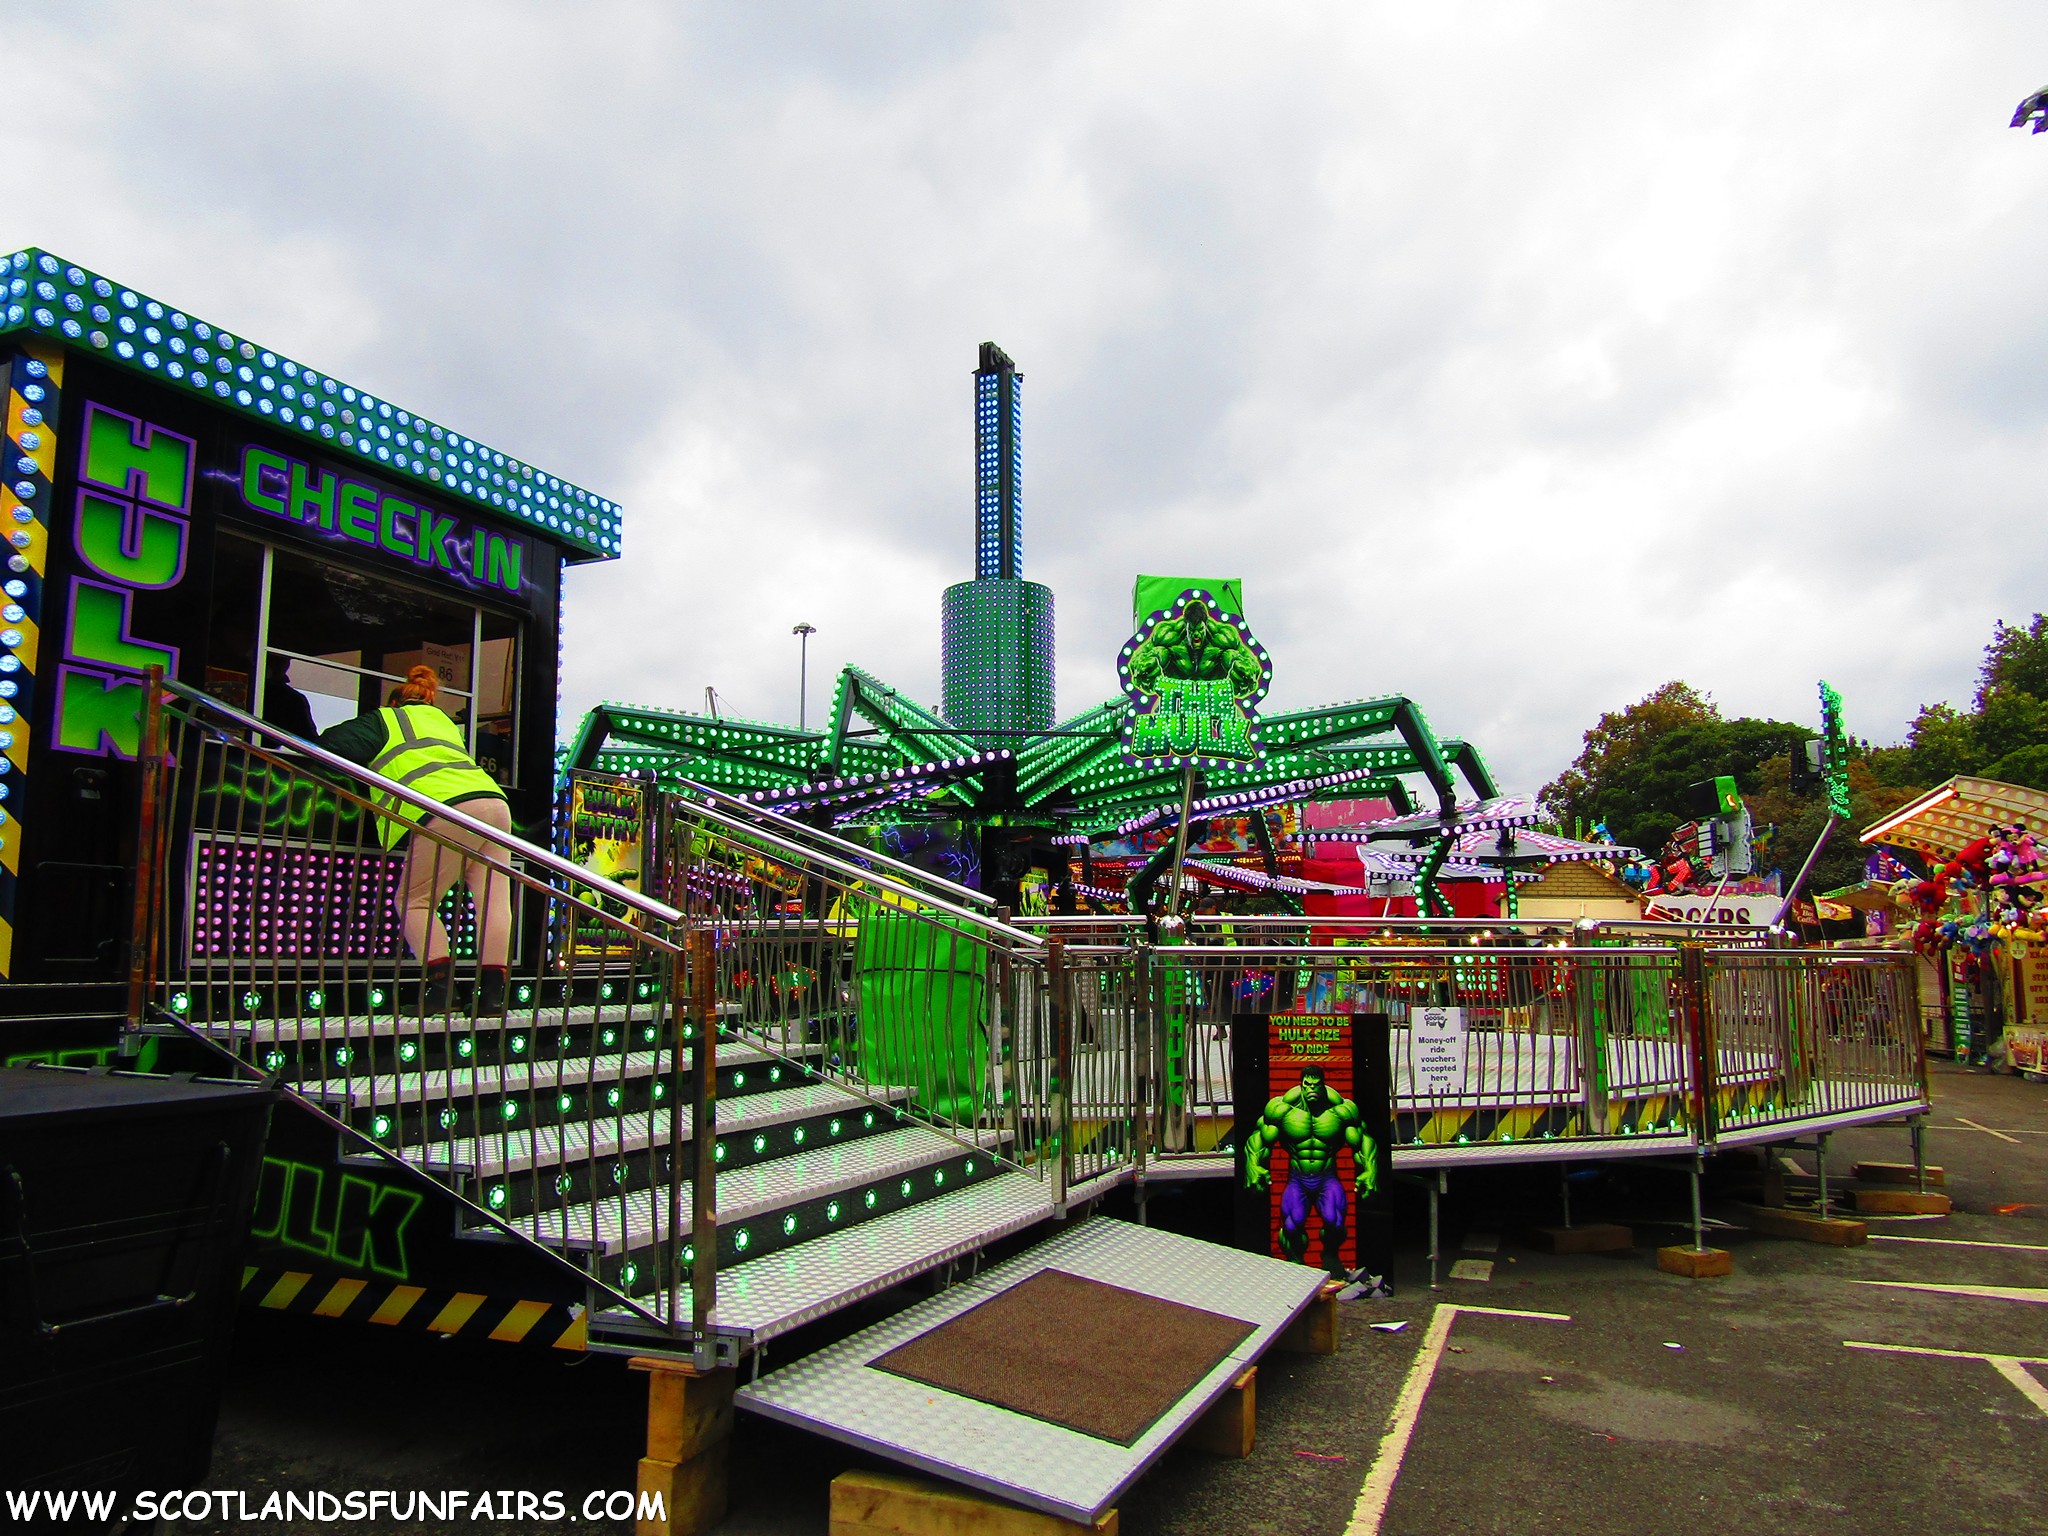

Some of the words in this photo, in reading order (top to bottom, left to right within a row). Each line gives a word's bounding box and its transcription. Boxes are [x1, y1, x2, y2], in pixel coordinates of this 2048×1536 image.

[240, 444, 459, 572] CHECK
[470, 529, 524, 593] IN
[51, 399, 197, 767] HULK
[438, 666, 453, 682] 86
[1155, 676, 1236, 717] THE
[1131, 713, 1257, 763] HULK
[479, 756, 497, 773] £6
[584, 788, 635, 818] HULK
[575, 813, 640, 843] ENTRY
[1269, 1015, 1291, 1026] YOU
[1292, 1016, 1319, 1026] NEED
[1321, 1016, 1335, 1026] TO
[1336, 1016, 1350, 1026] BE
[1278, 1028, 1312, 1041] HULK
[1314, 1028, 1341, 1041] SIZE
[1418, 1036, 1457, 1045] Money-off
[1290, 1043, 1305, 1054] TO
[1306, 1043, 1330, 1054] RIDE
[1165, 1012, 1185, 1108] HULK
[1420, 1055, 1457, 1063] vouchers
[1421, 1065, 1457, 1073] accepted
[251, 1157, 424, 1279] ULK
[694, 1331, 703, 1339] 19
